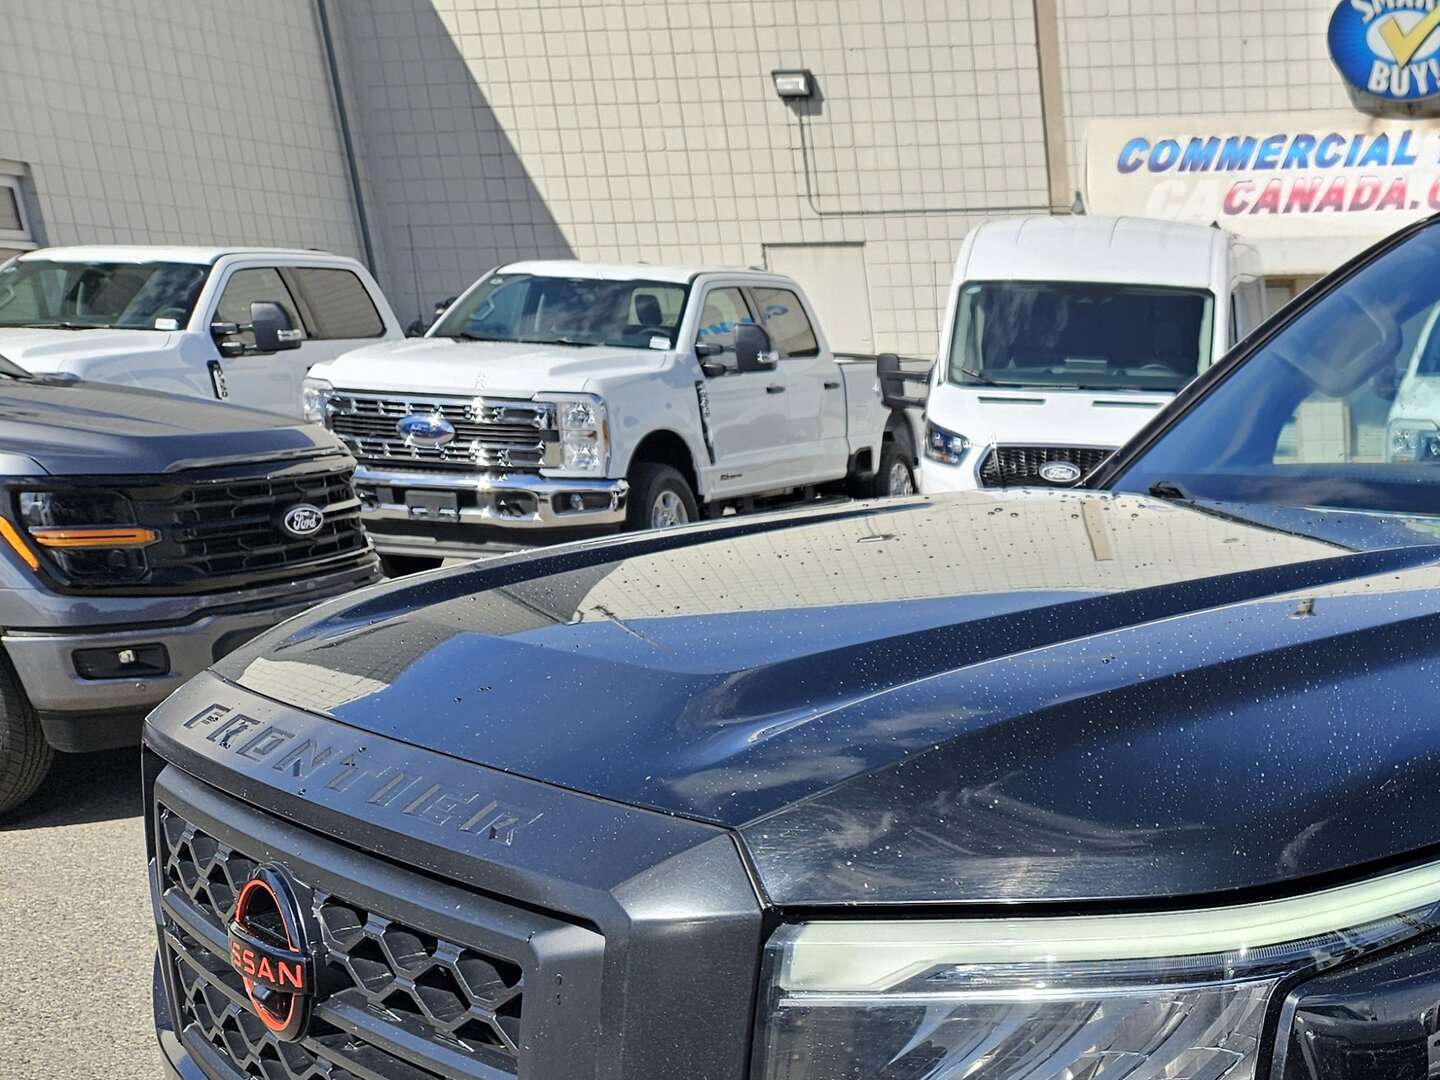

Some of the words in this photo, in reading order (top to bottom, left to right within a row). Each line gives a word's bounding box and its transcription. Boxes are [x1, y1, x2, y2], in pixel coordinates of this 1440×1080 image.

[1116, 129, 1416, 174] COMMERCIAL
[291, 510, 319, 531] Ford
[182, 702, 545, 847] FRONTIER
